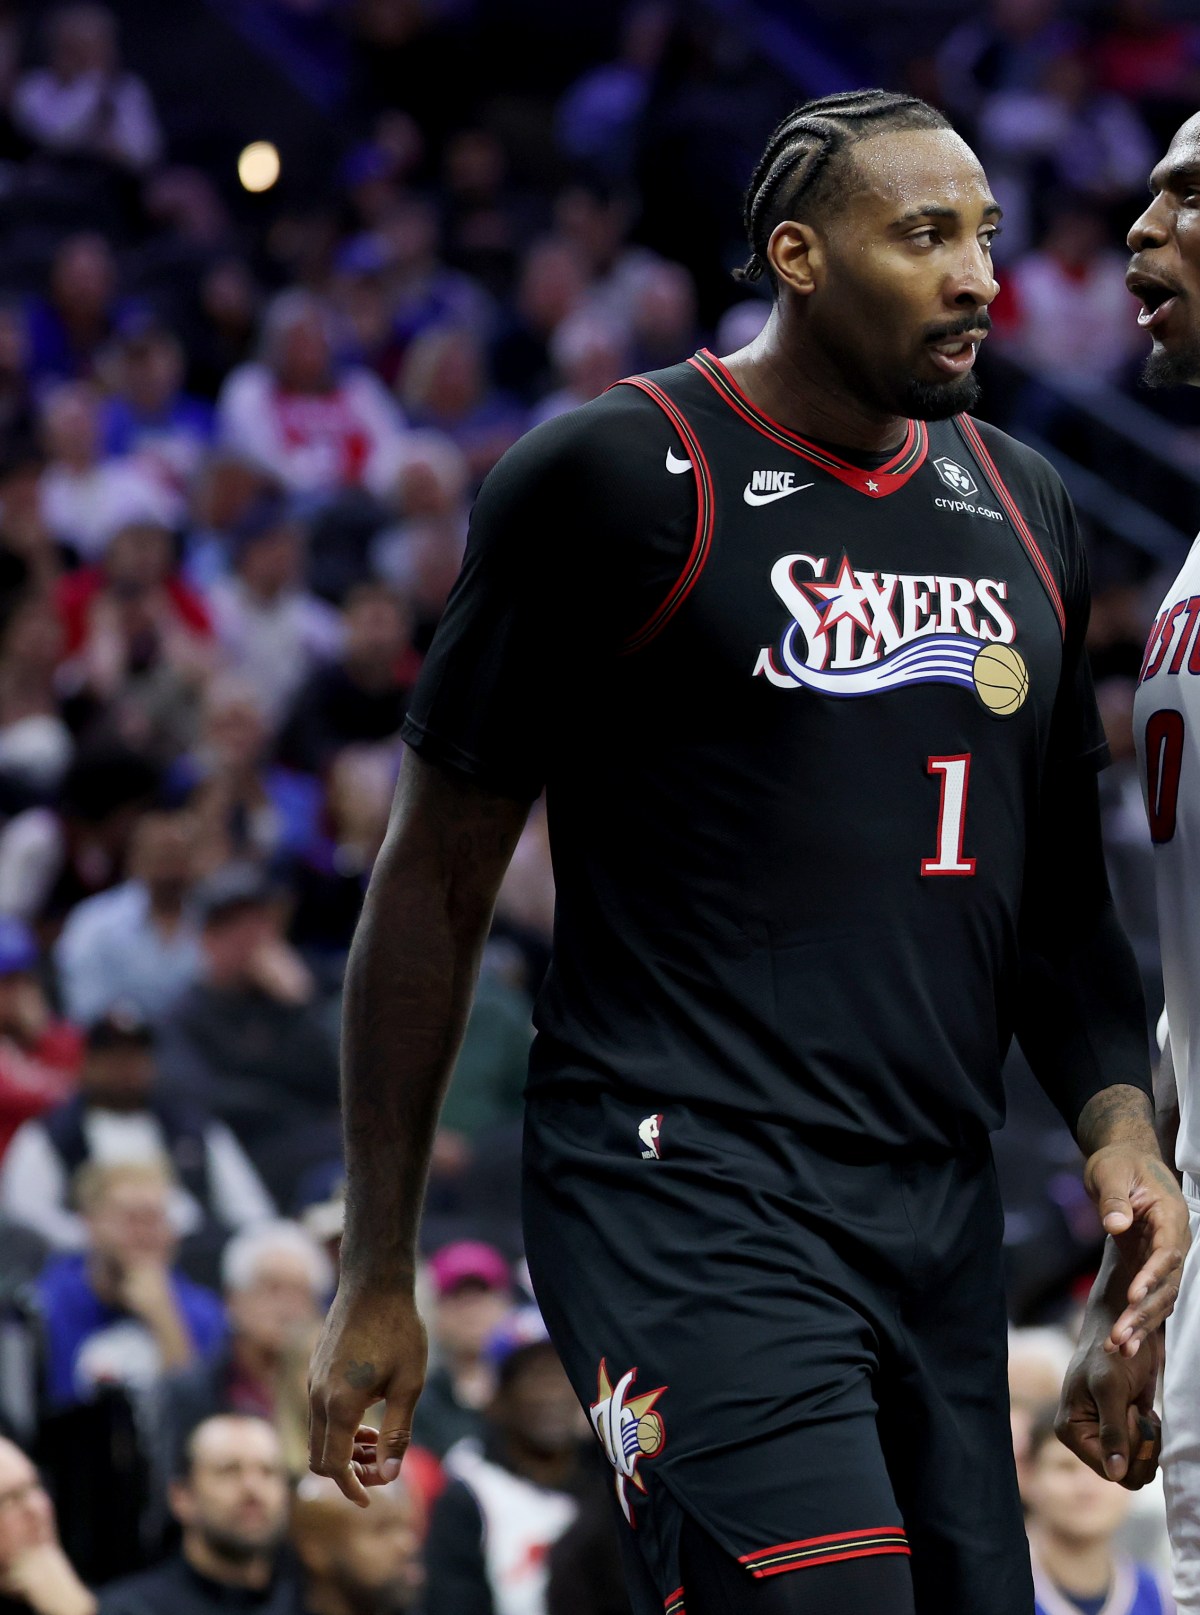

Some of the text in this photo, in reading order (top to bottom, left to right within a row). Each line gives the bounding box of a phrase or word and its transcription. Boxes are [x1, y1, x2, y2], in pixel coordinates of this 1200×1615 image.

[751, 470, 796, 491] NIKE
[934, 497, 1004, 521] crypto.com
[1145, 709, 1184, 843] 0
[921, 753, 976, 876] 1
[641, 1150, 655, 1160] NBA
